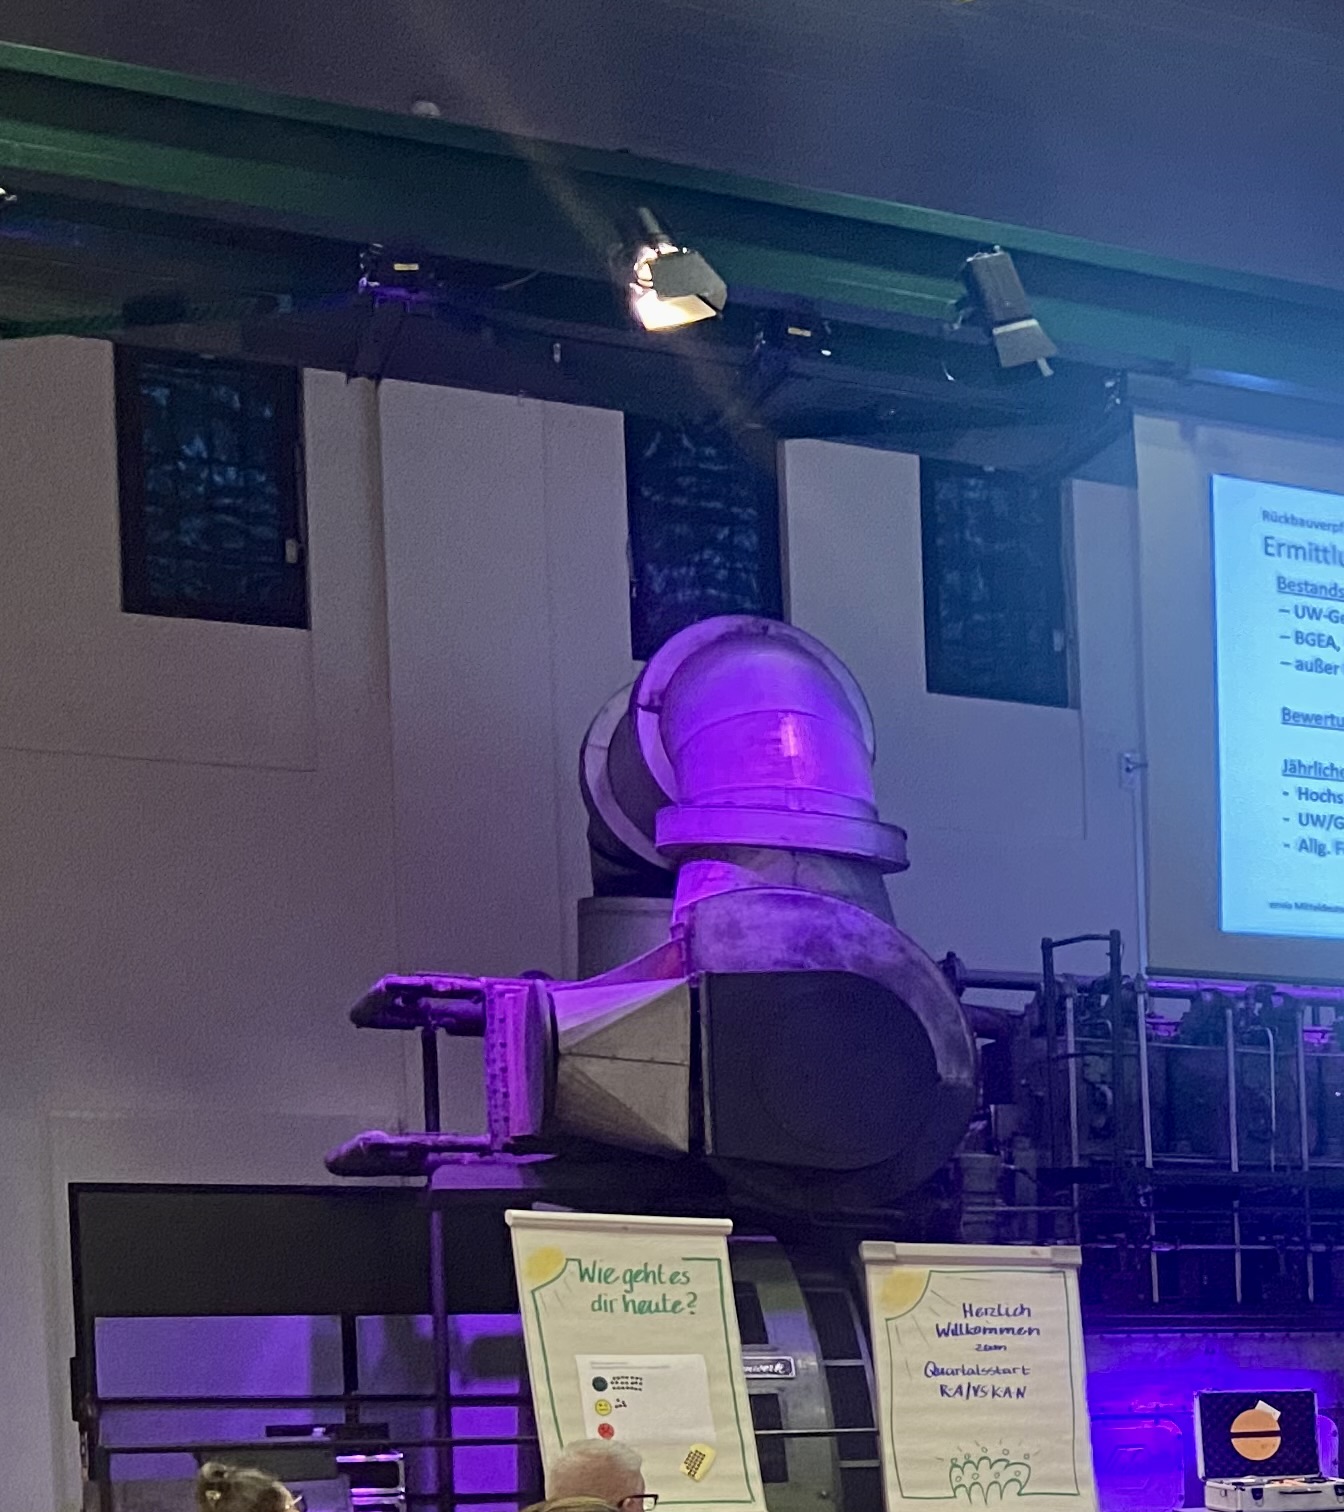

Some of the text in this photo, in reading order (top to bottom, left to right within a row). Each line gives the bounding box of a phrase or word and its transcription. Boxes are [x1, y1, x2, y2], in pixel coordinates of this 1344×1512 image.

[1294, 631, 1340, 652] BGEA,
[1294, 657, 1339, 675] außer
[1298, 838, 1330, 857] Allg.
[578, 1260, 691, 1293] Wie geht es
[591, 1291, 697, 1315] dir heute?
[962, 1302, 1032, 1319] Herzlich
[935, 1322, 1041, 1338] Willkommen
[924, 1360, 1031, 1378] Quartalsstart
